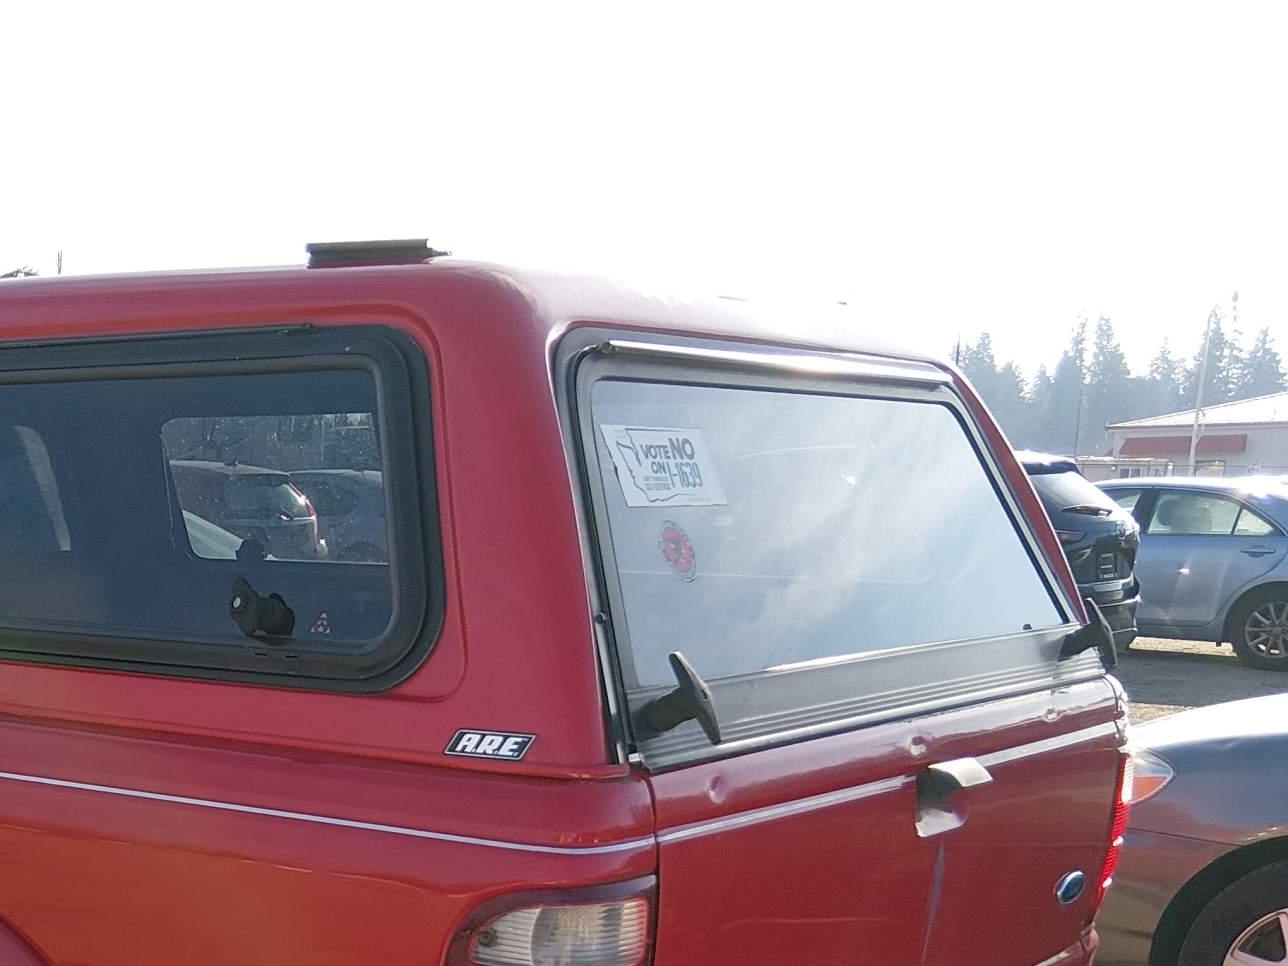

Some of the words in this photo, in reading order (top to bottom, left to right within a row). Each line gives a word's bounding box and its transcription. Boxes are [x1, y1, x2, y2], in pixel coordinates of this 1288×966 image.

[640, 444, 671, 460] VOTE
[668, 437, 695, 460] NO
[651, 461, 667, 474] ON
[666, 462, 703, 488] I-1639
